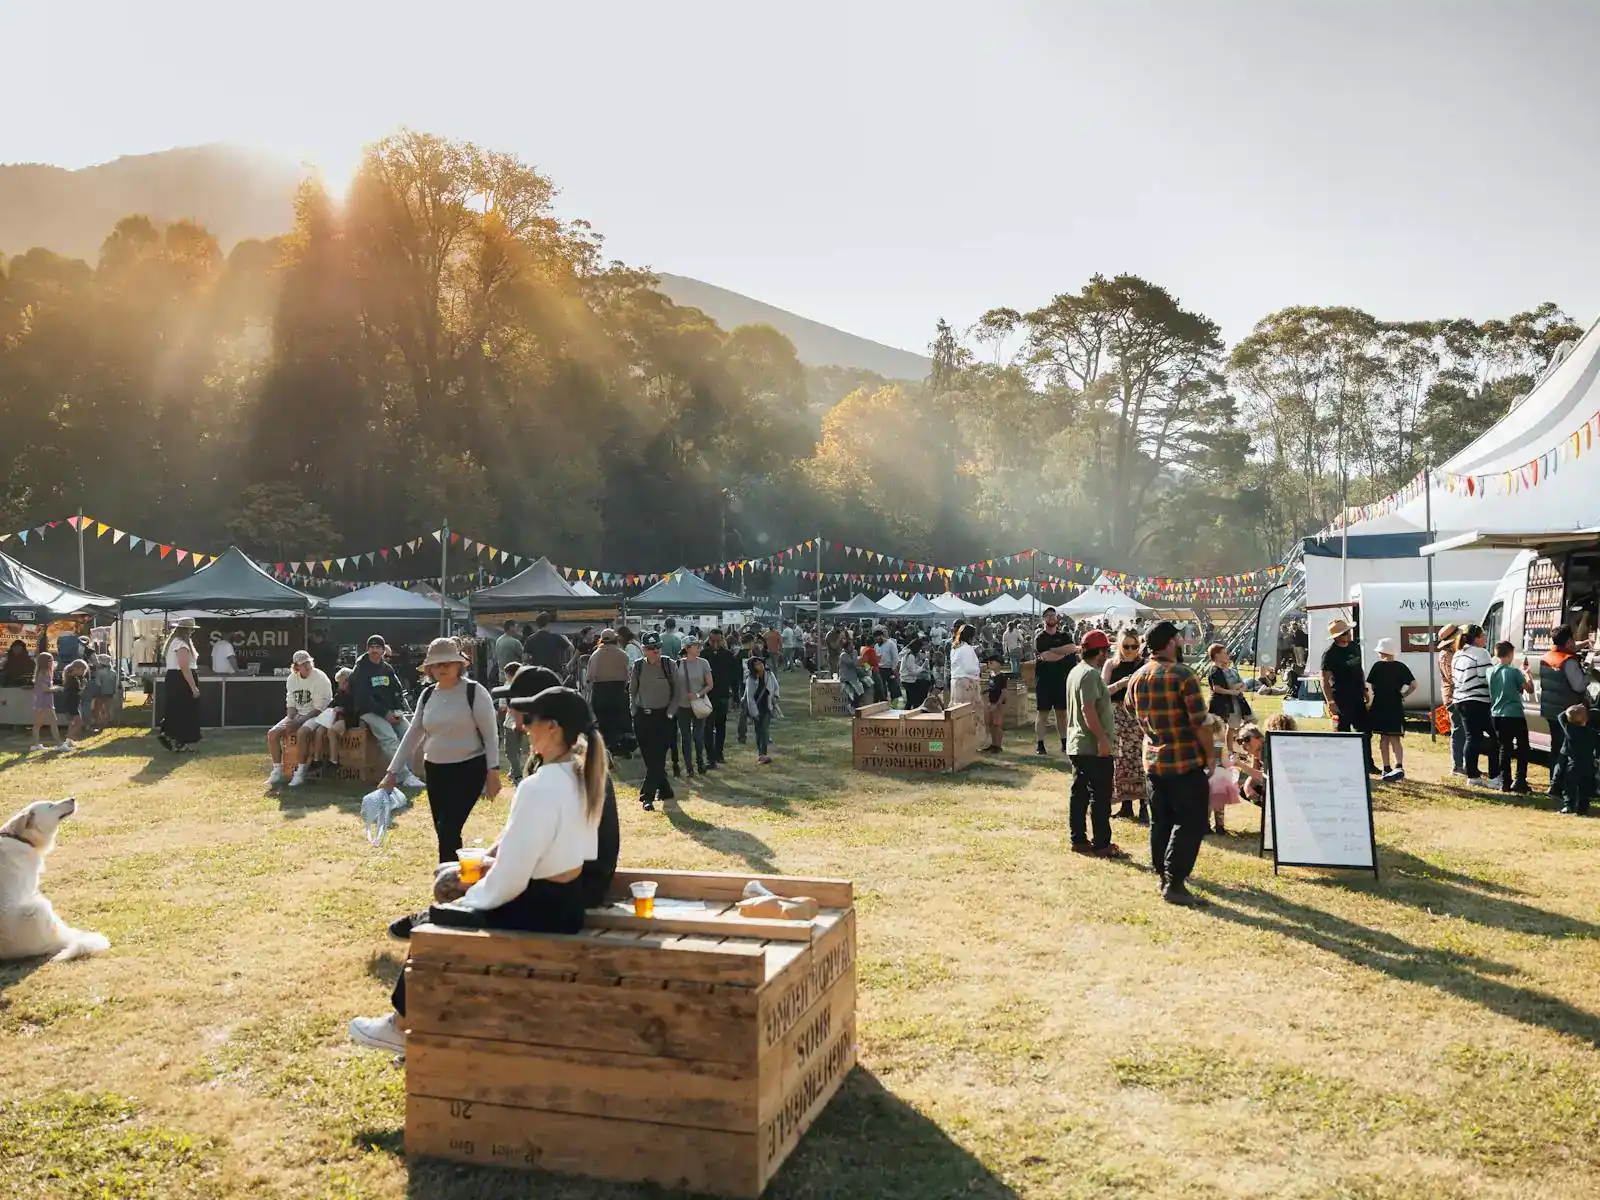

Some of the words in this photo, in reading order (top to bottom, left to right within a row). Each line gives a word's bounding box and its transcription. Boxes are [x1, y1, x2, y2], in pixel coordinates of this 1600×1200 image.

[210, 630, 289, 647] SCARII
[861, 756, 946, 770] NIGHTINGALE
[767, 1030, 852, 1163] NIGHTINGALE
